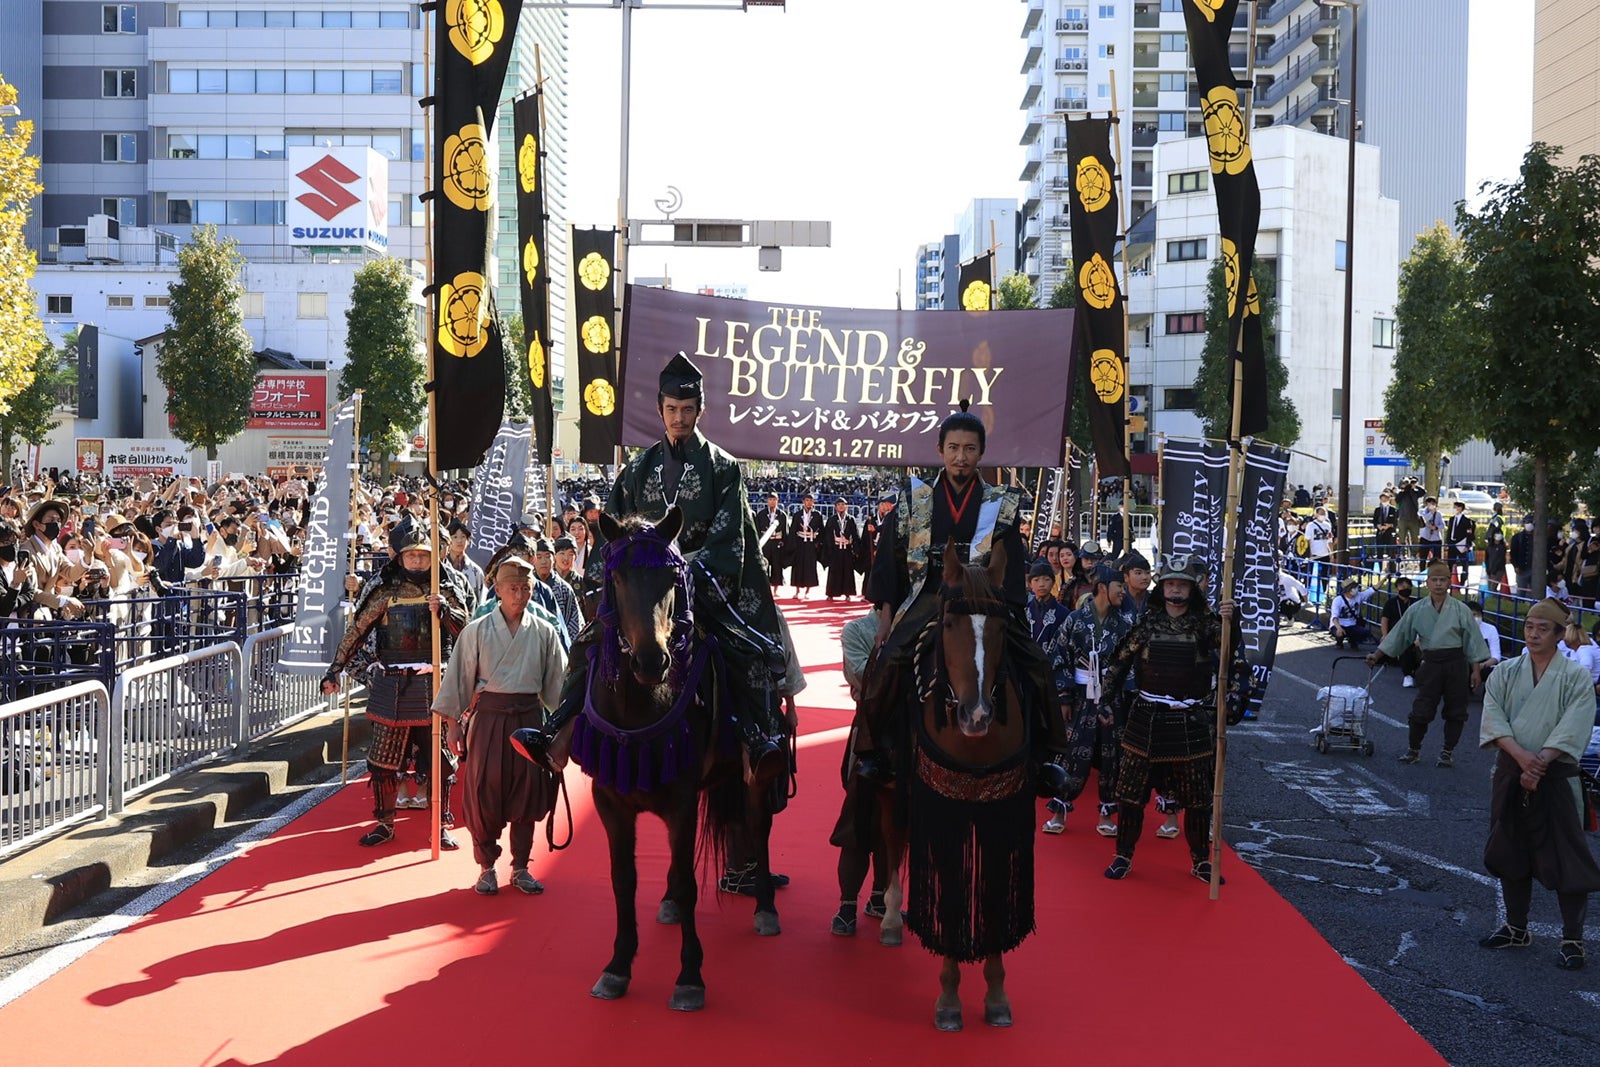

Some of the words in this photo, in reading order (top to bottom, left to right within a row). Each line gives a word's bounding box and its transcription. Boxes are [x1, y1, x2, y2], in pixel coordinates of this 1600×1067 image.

[292, 227, 364, 239] SUZUKI
[767, 306, 822, 329] THE
[694, 316, 889, 368] LEGEND
[897, 337, 926, 368] &
[728, 357, 1004, 406] BUTTERFLY
[729, 403, 943, 434] レジェンド&バタフラ
[779, 435, 874, 458] 2023.1.27
[877, 446, 903, 459] FRI
[1176, 511, 1194, 527] &
[1192, 471, 1209, 560] ERFLY
